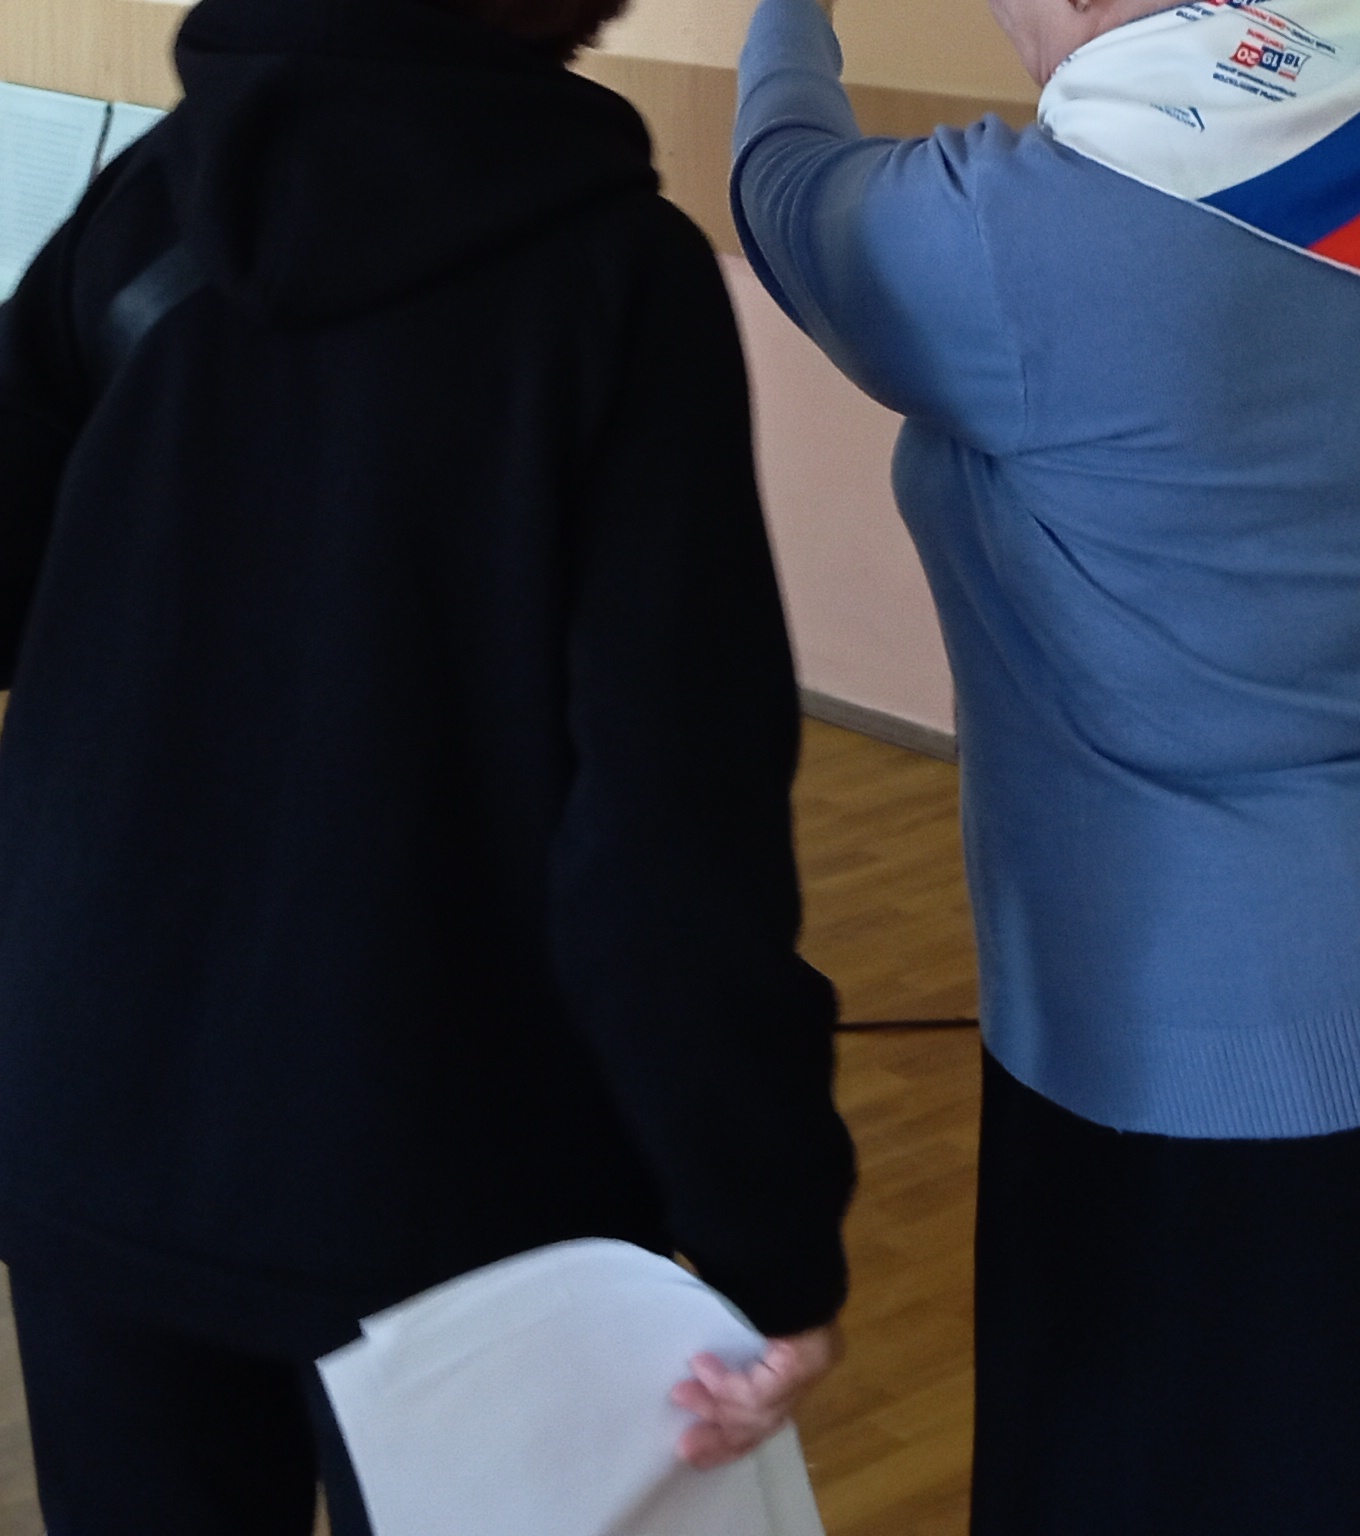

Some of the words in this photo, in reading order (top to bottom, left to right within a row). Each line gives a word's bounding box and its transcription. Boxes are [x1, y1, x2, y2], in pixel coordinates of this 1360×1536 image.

[1237, 47, 1260, 65] 20
[1262, 51, 1278, 68] 19
[1284, 52, 1300, 68] 18
